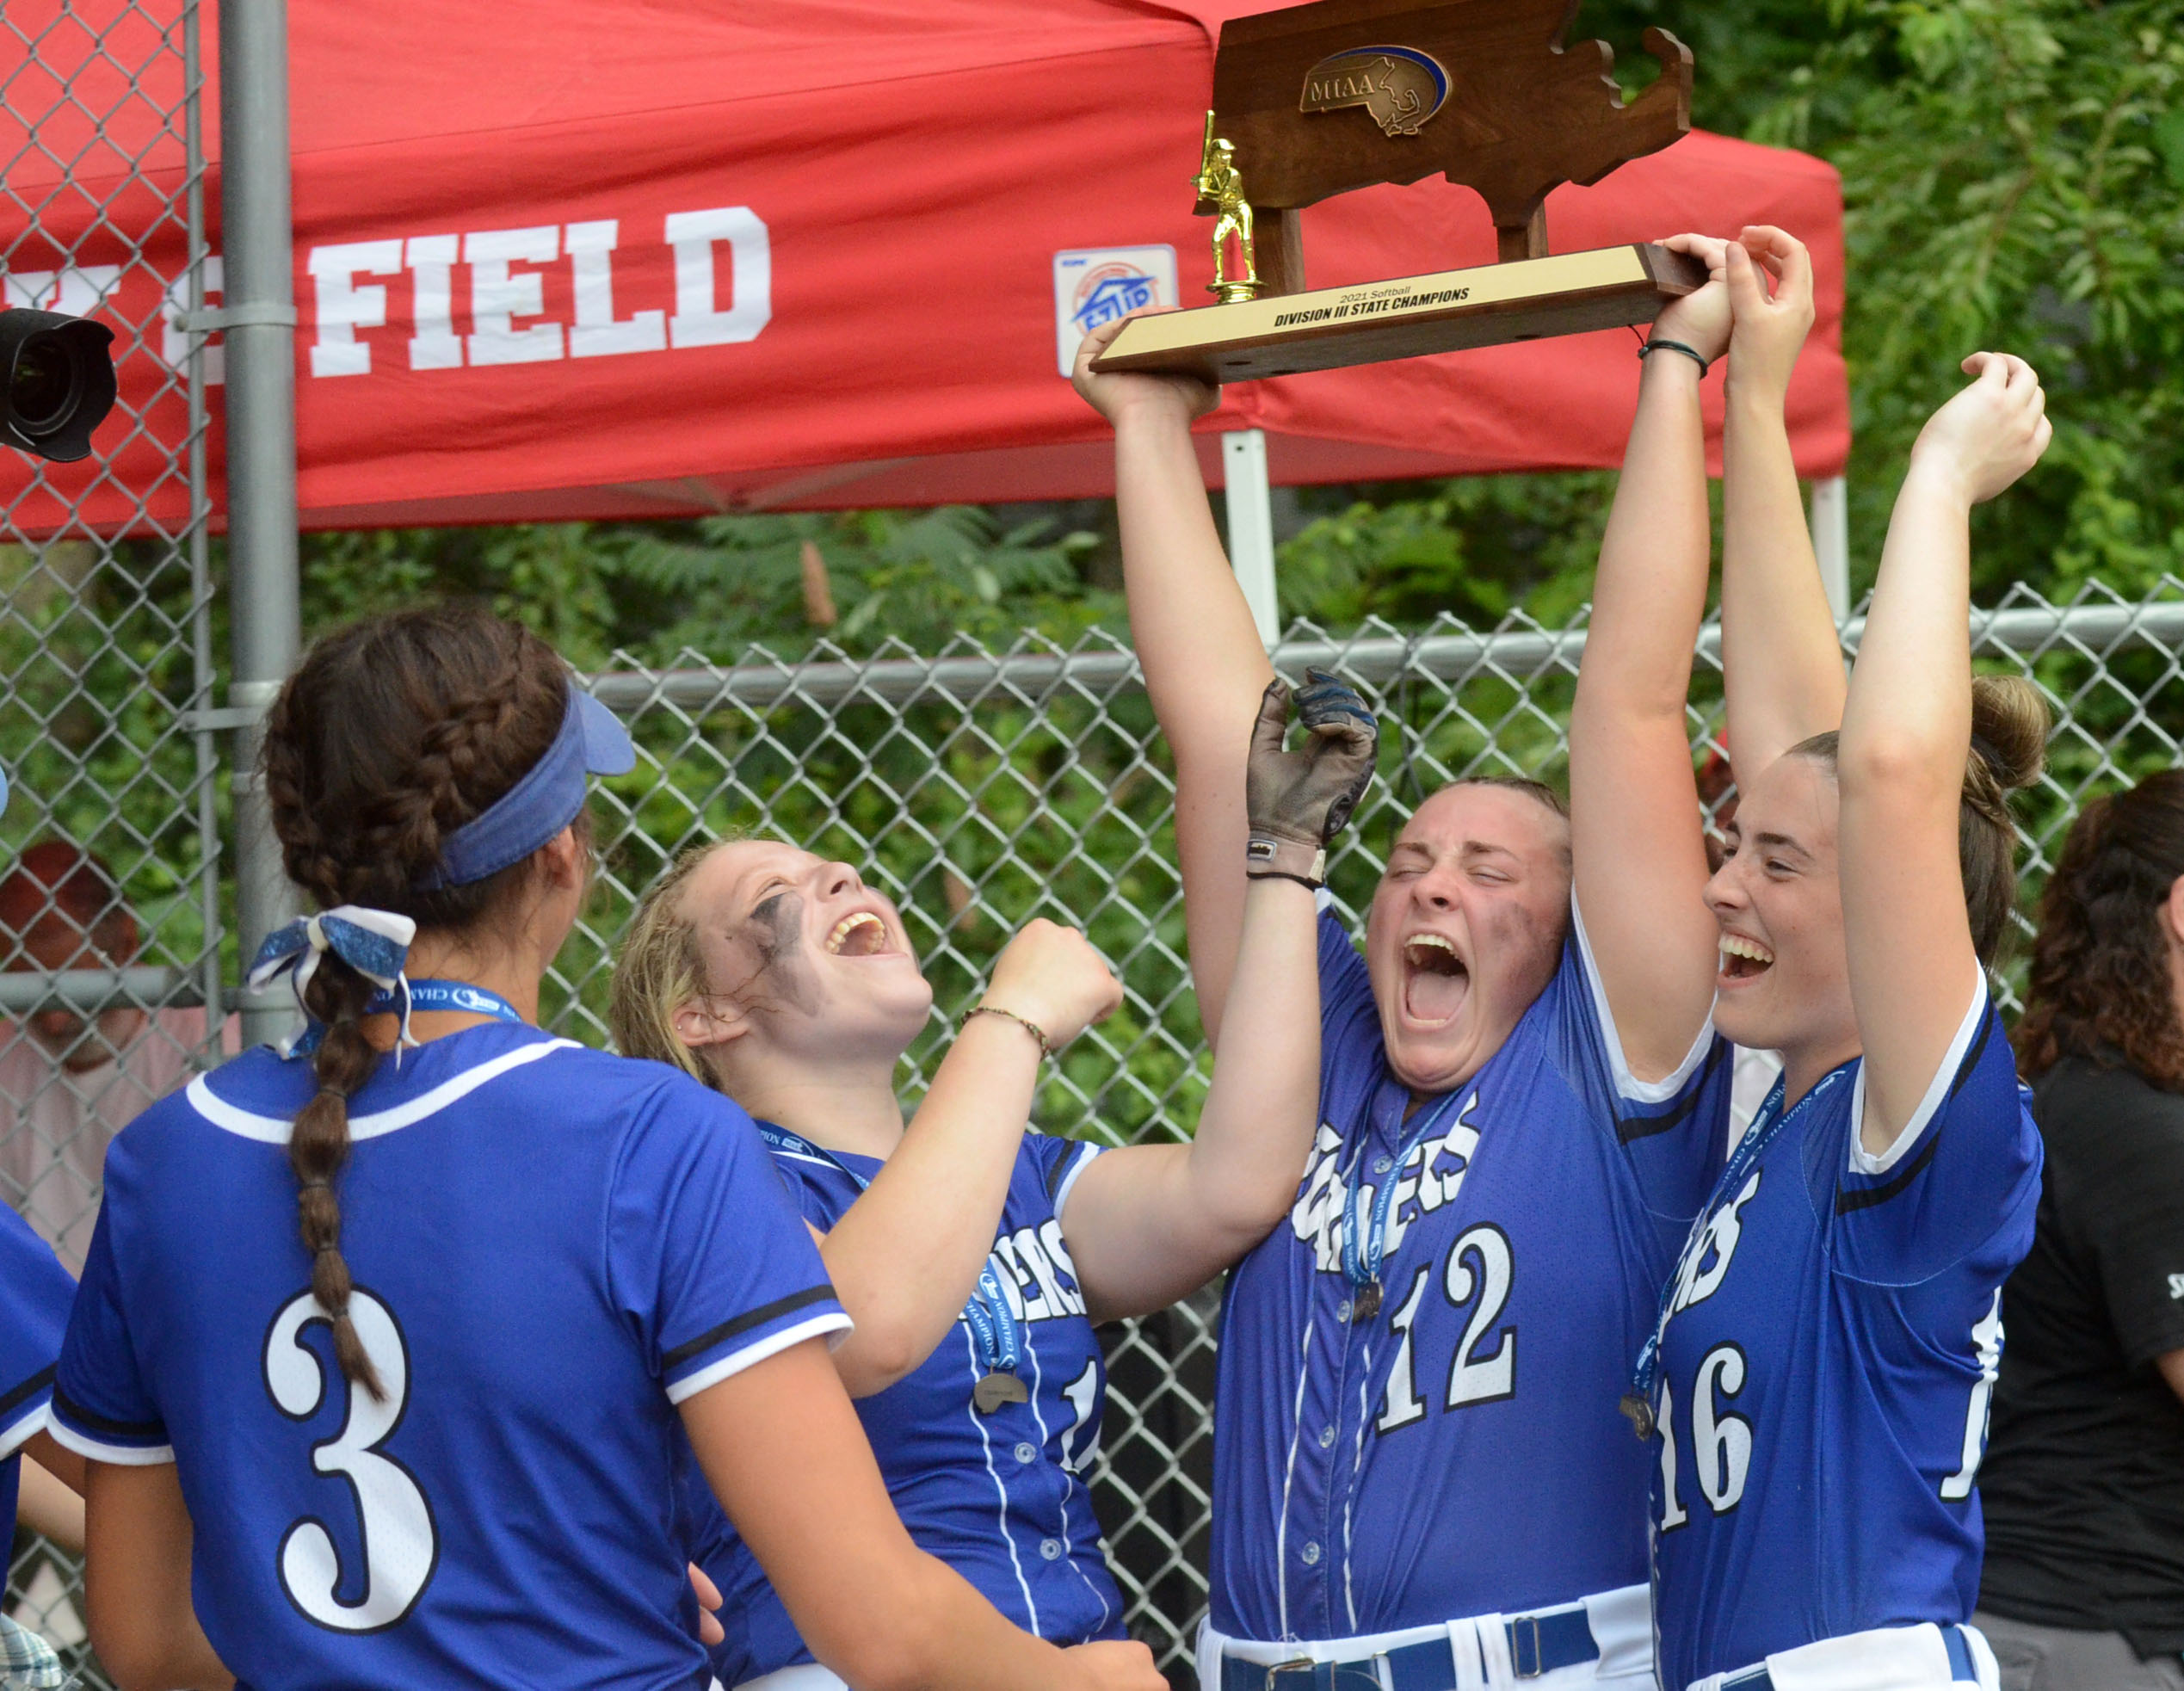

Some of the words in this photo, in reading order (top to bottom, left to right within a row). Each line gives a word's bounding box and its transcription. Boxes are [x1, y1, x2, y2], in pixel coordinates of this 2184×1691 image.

[1311, 74, 1376, 102] MIAA
[307, 206, 772, 378] FIELD
[1274, 307, 1333, 327] DIVISION
[1334, 305, 1350, 318] III
[1350, 298, 1391, 316] STATE
[1391, 287, 1470, 310] CHAMPIONS
[1340, 293, 1367, 304] 2021
[1370, 286, 1411, 299] Softball
[1375, 1220, 1517, 1437] 12
[262, 1284, 439, 1635] 3
[1659, 1339, 1754, 1533] 16
